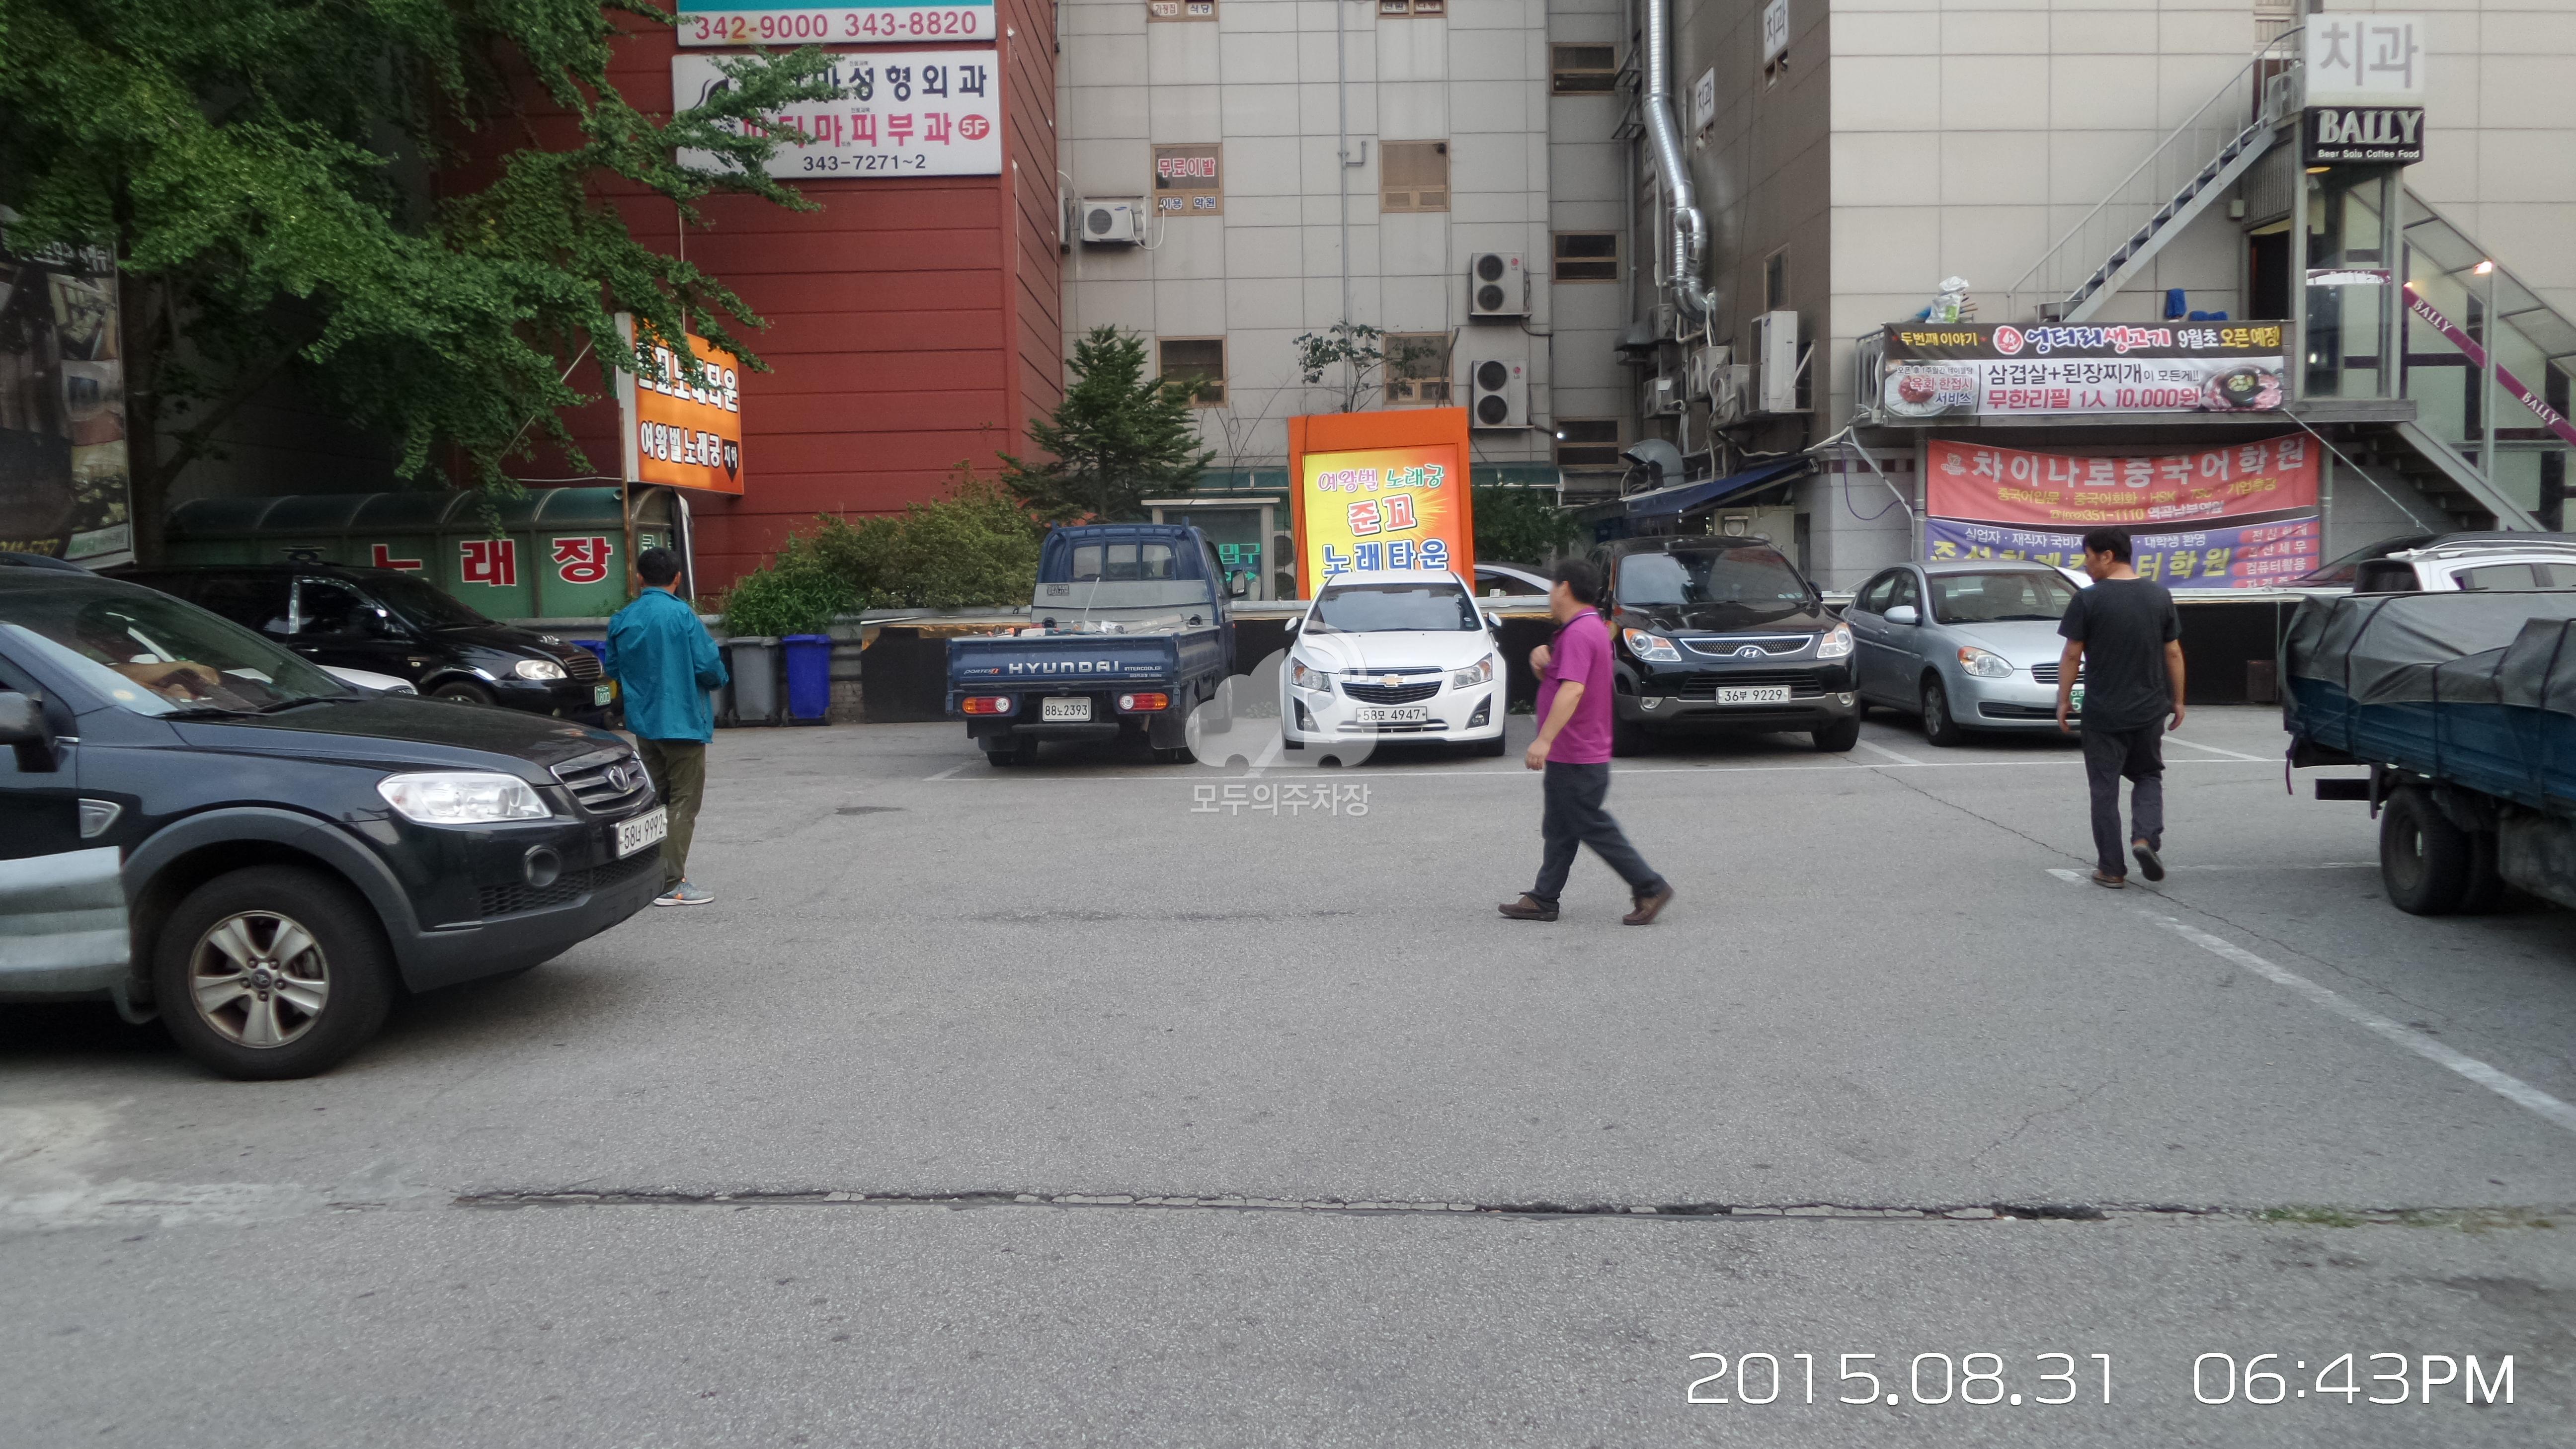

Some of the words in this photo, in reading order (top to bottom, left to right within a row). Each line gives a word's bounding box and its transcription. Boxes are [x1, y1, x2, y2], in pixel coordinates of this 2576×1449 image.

[695, 14, 828, 39] 342-9000
[844, 11, 976, 36] 343-8820
[1767, 5, 1785, 45] 치과
[2321, 22, 2419, 87] 치과
[1697, 78, 1712, 115] 치과
[961, 120, 986, 134] 5F
[2317, 109, 2423, 143] BALLY
[804, 154, 926, 172] 343-7271~2
[2319, 149, 2339, 158] Beer
[1158, 158, 1215, 177] 무료이발
[1161, 197, 1183, 209] 이용
[2414, 300, 2453, 332] BALLY
[1901, 332, 1939, 346] 두번째
[1940, 332, 1979, 346] 이야기
[1911, 377, 1935, 390] 육회
[1939, 377, 1973, 390] 한접시
[1935, 392, 1972, 405] 서비스
[1987, 388, 2070, 409] 무한리필
[2115, 388, 2201, 408] 10,000원
[2522, 392, 2560, 424] BALLY
[641, 420, 681, 463] 여왕벌
[684, 428, 720, 468] 노래궁
[1972, 437, 2306, 488] 차이나로중국어학원
[1318, 468, 1378, 493] 여왕벌
[1385, 464, 1445, 489] 노래궁
[1322, 538, 1450, 577] 노래타운
[1009, 660, 1119, 674] HYUNDAI
[1724, 690, 1747, 702] 36부
[1753, 689, 1783, 701] 9229
[1045, 705, 1088, 716] 88노2393
[1363, 709, 1385, 721] 58모
[1390, 709, 1420, 721] 4947
[644, 813, 664, 840] 9992
